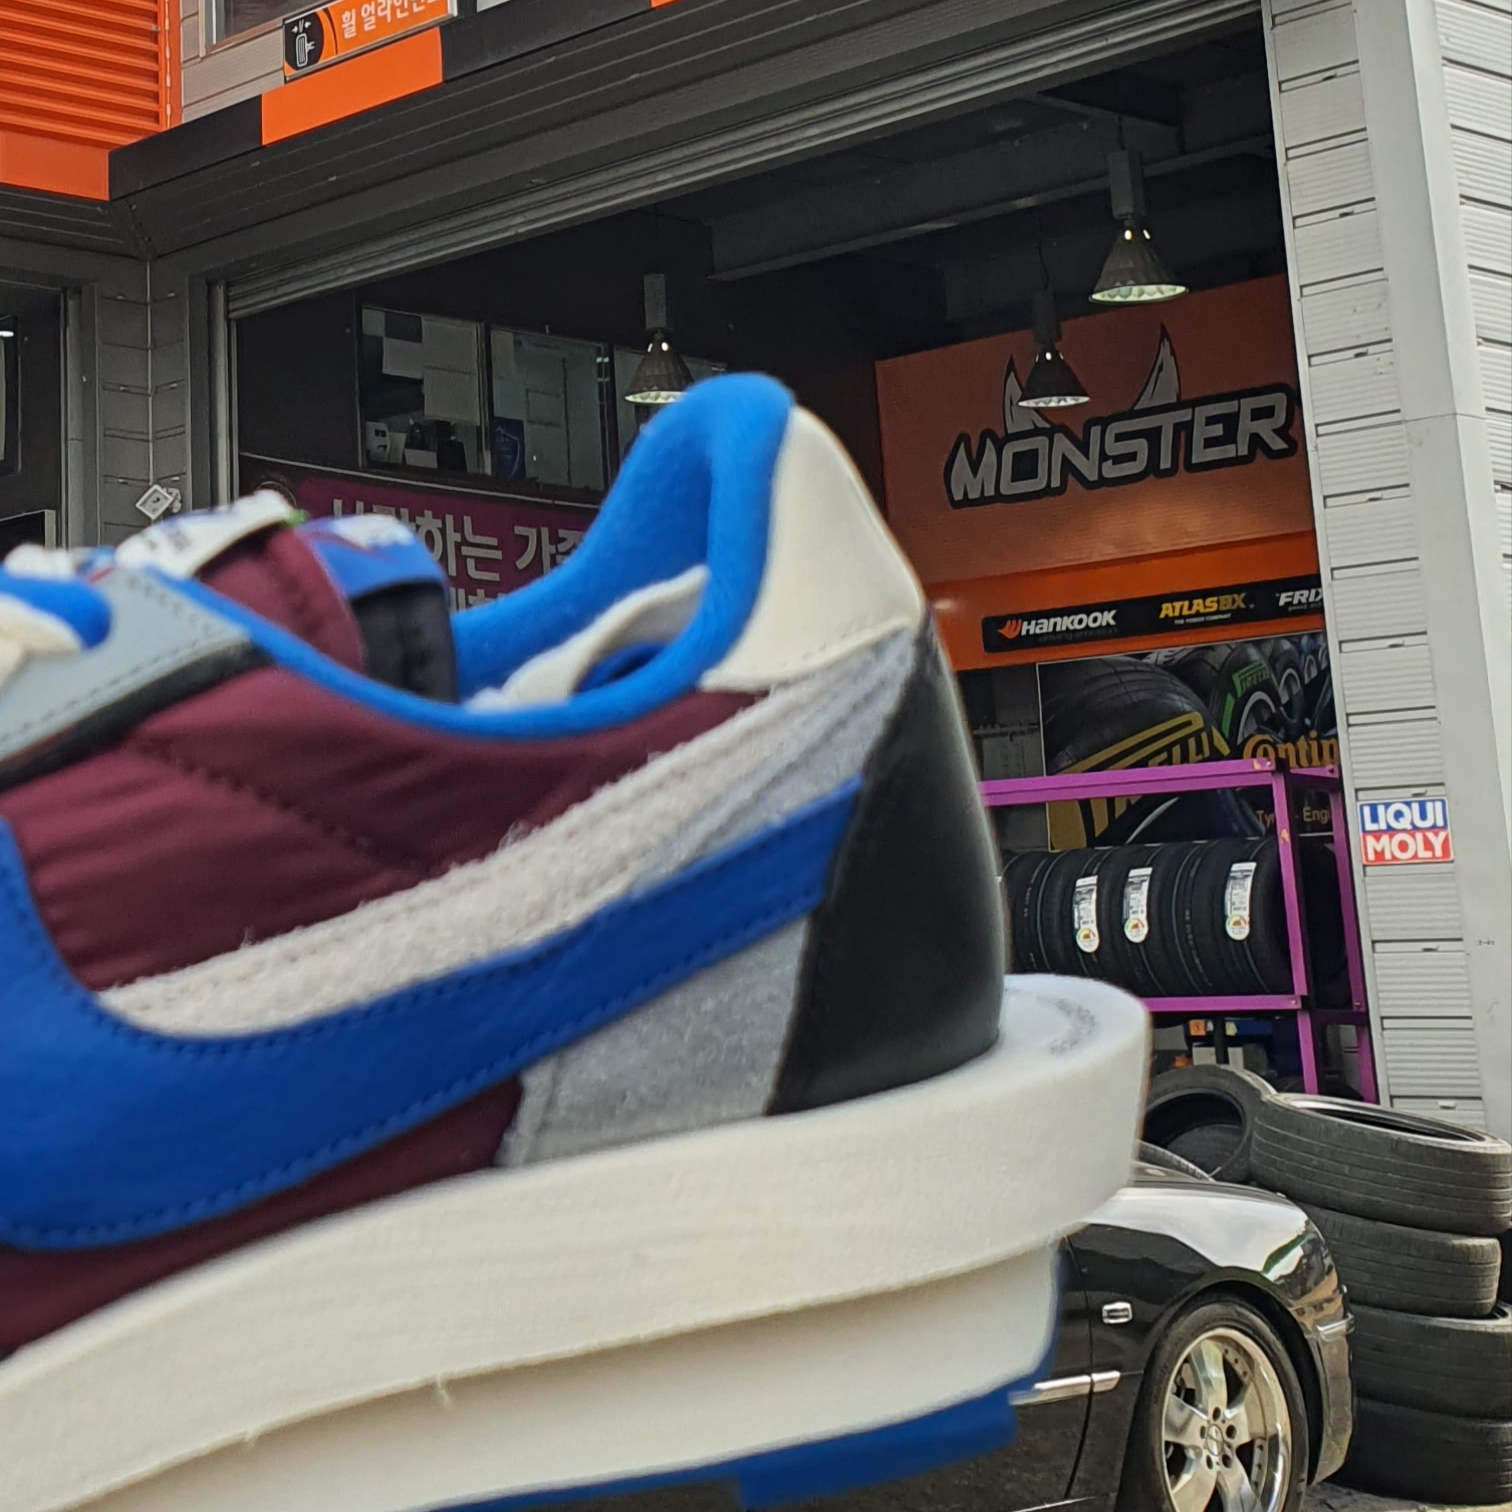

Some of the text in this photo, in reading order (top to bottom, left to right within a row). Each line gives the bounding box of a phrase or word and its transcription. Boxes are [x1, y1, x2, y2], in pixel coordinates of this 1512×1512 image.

[948, 392, 1292, 502] MONSTER
[1158, 592, 1248, 620] ATLASBX
[1363, 800, 1445, 831] LIQUI
[1365, 831, 1448, 862] MOLY
